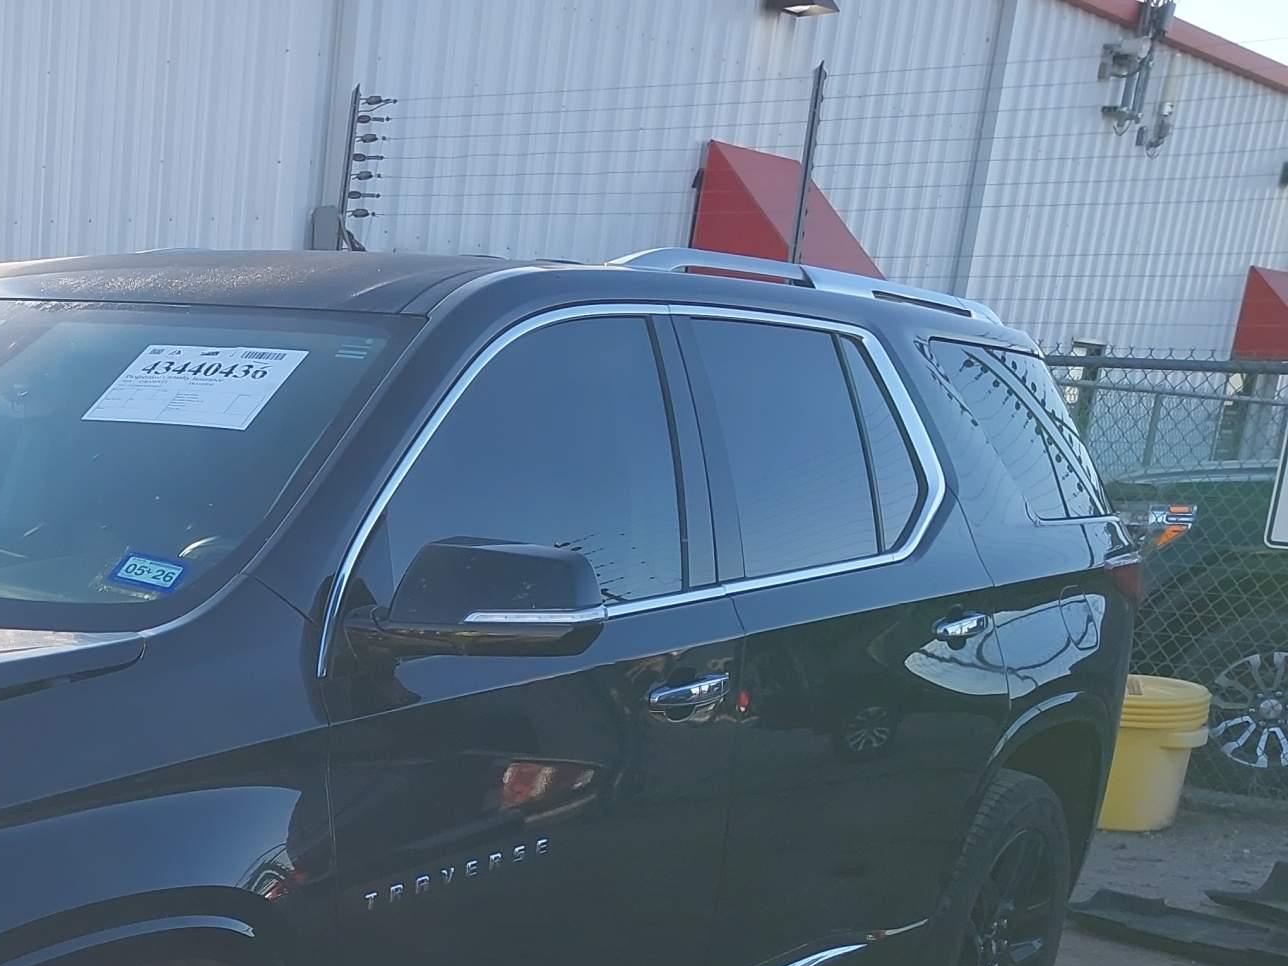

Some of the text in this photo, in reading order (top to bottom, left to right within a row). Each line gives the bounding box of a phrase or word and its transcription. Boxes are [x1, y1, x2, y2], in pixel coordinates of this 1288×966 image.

[141, 360, 273, 380] 43440436
[152, 569, 176, 583] 26
[364, 837, 549, 910] TRAVERSE
